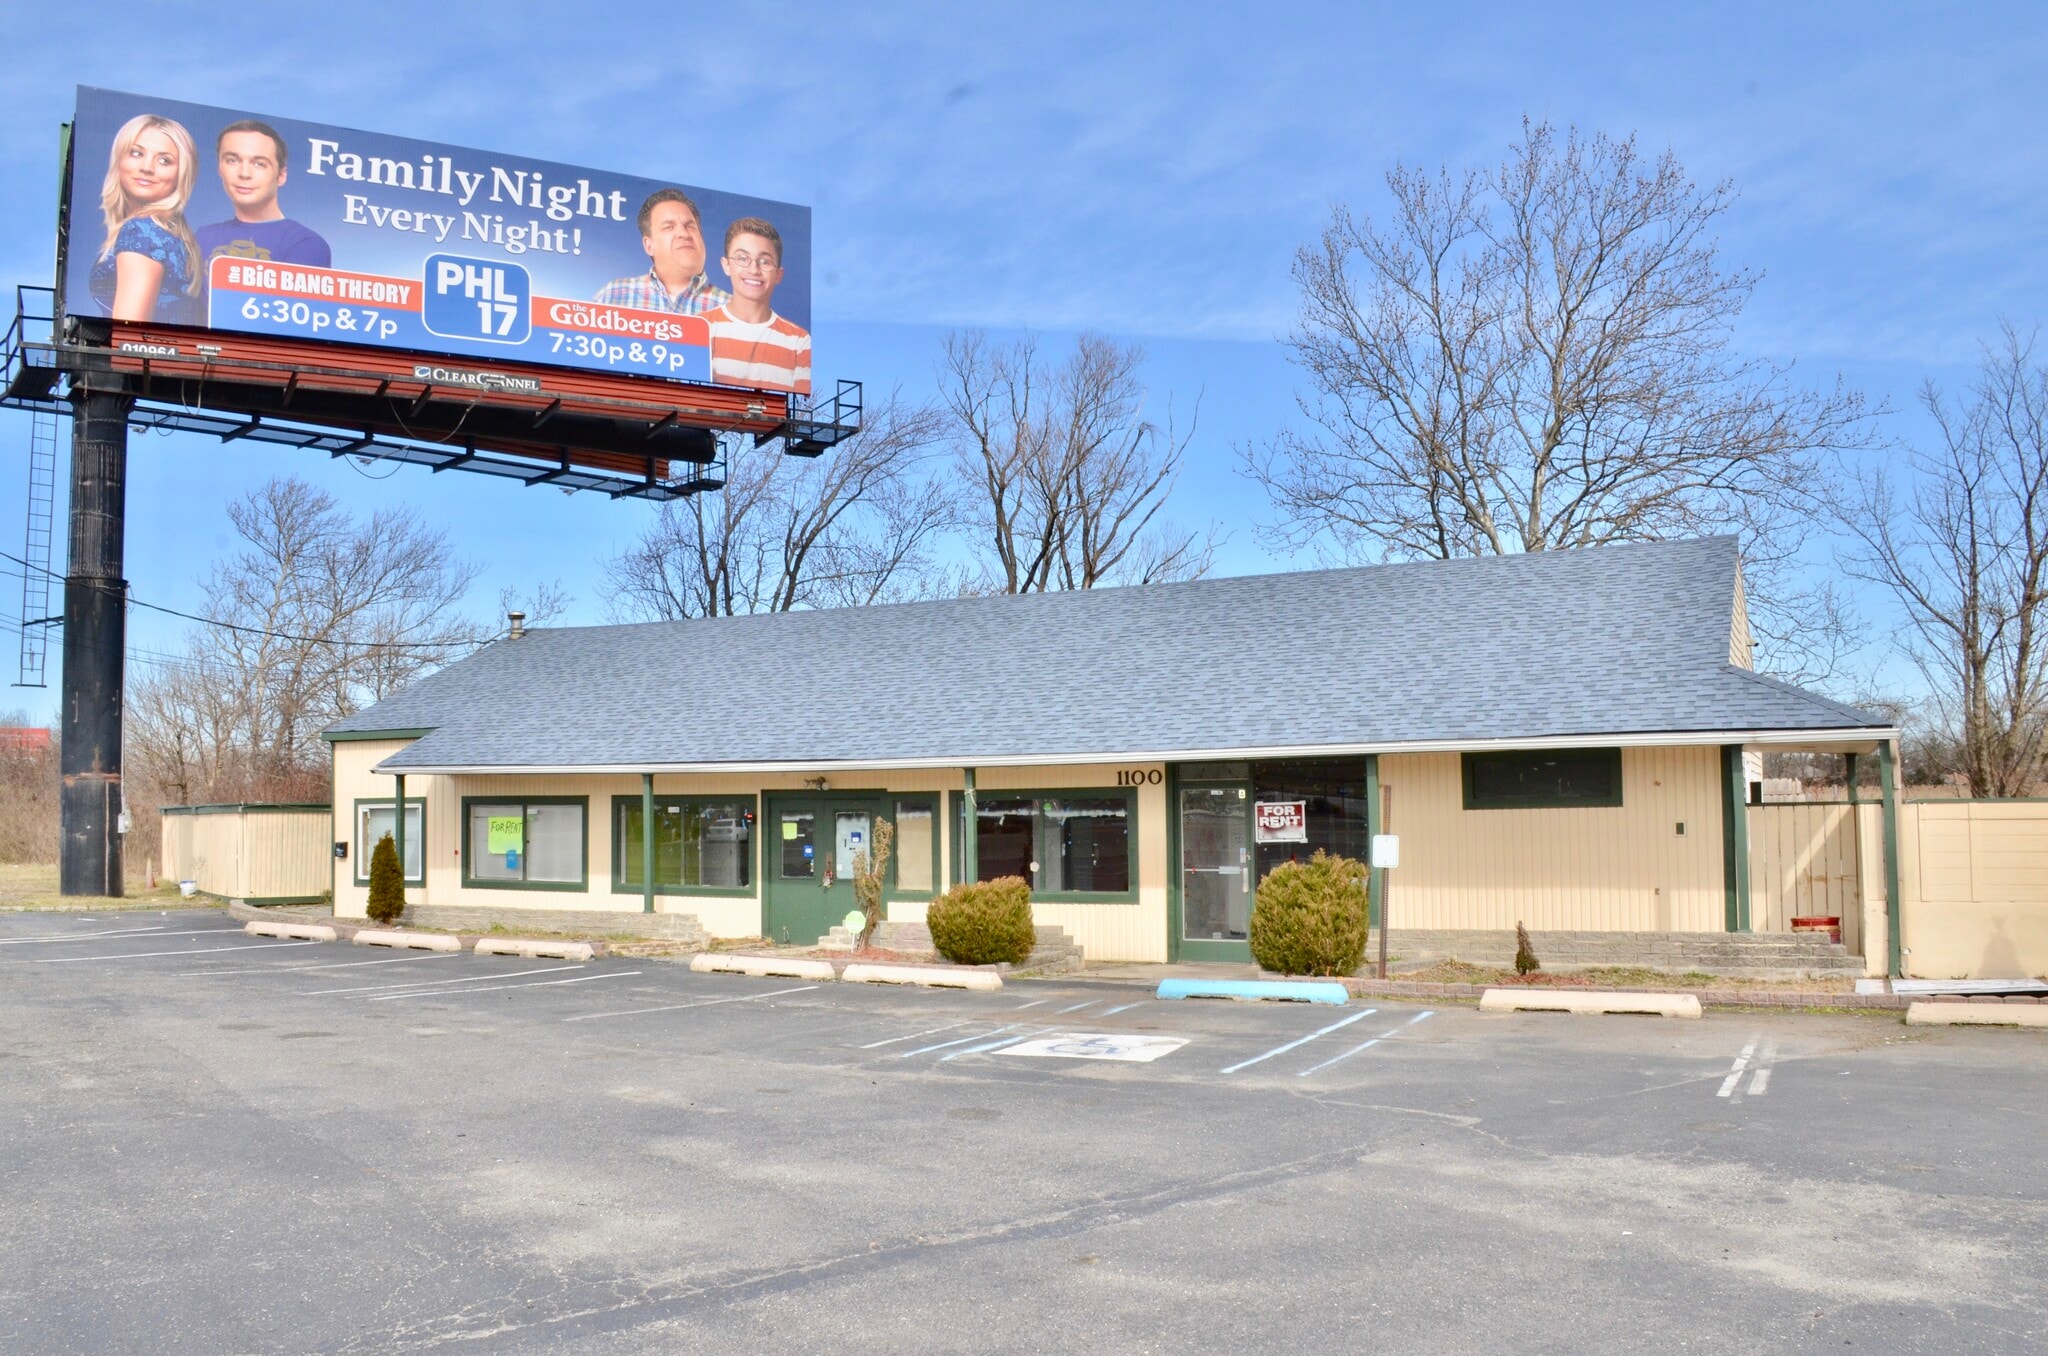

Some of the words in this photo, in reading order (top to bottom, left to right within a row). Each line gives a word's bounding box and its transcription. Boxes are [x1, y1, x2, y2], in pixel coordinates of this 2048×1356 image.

[307, 138, 485, 206] Family
[489, 166, 627, 221] Night
[343, 194, 455, 243] Every
[461, 211, 581, 255] Night!
[280, 270, 335, 296] BANG
[337, 278, 411, 305] THEORY
[437, 261, 518, 304] PHL
[241, 297, 331, 332] 6:30p
[335, 308, 358, 331] &
[361, 310, 398, 340] 7p
[477, 302, 518, 337] 17
[549, 303, 683, 341] Goldbergs
[549, 332, 624, 364] 7:30p
[628, 343, 648, 364] &
[652, 344, 685, 371] 9p
[1117, 769, 1163, 786] 1100
[1259, 816, 1301, 828] RENT
[1263, 805, 1295, 816] FOR
